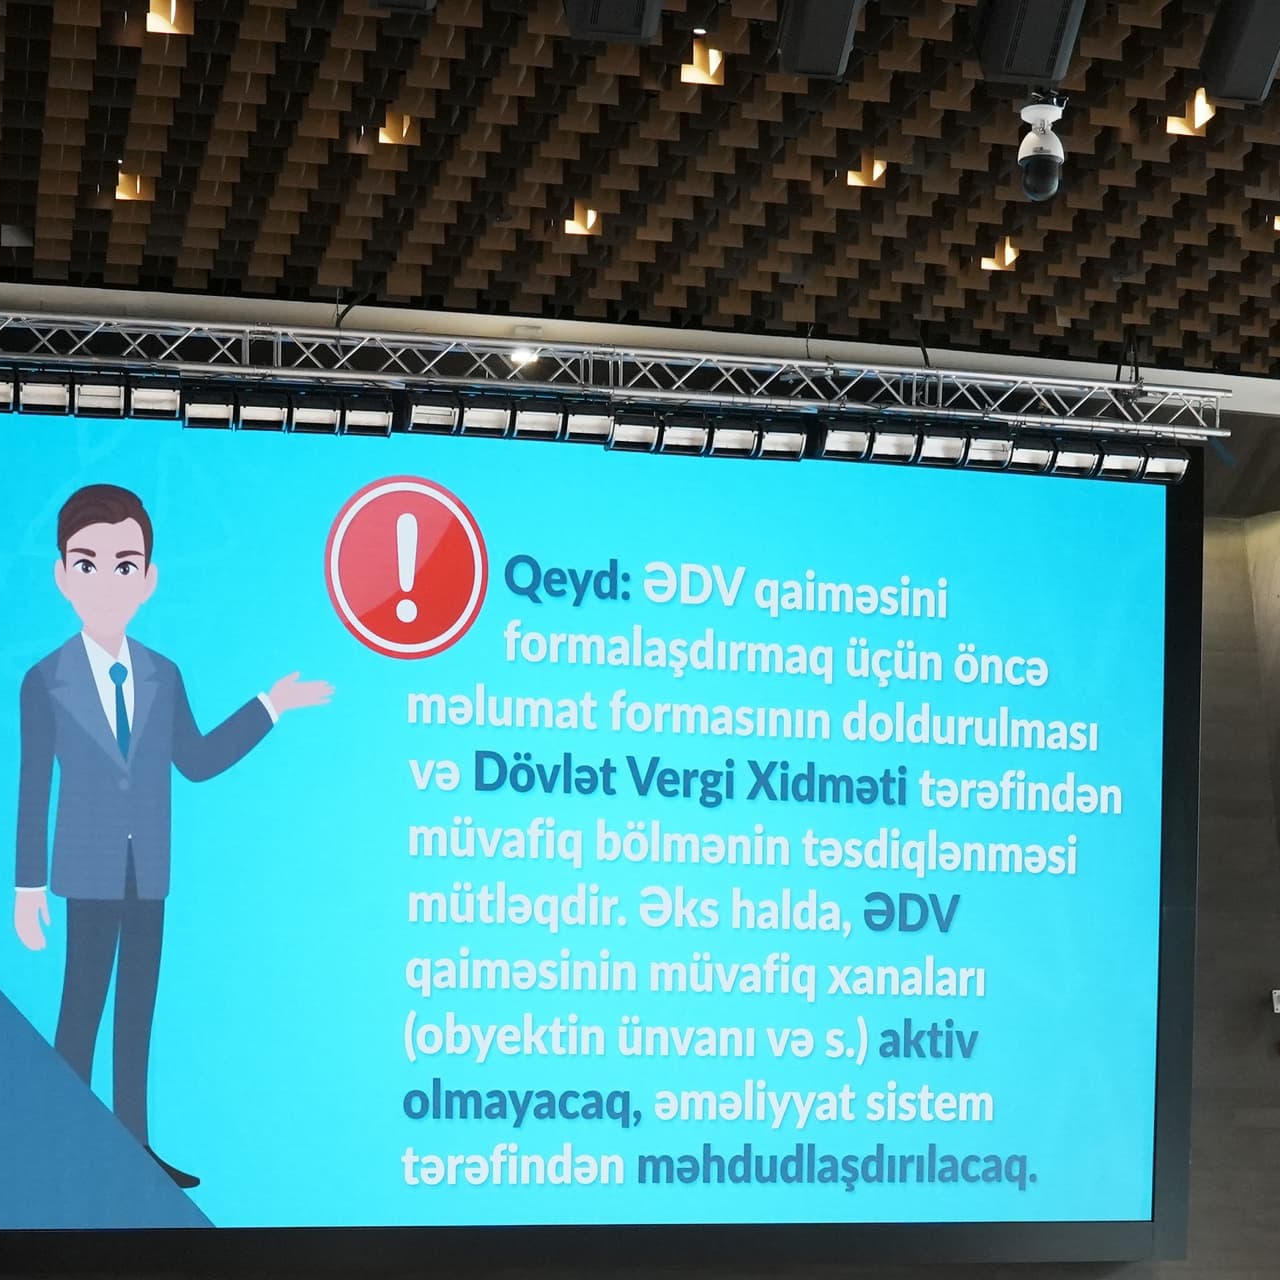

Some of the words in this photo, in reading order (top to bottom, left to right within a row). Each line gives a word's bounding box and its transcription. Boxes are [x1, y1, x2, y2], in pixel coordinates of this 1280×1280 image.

[505, 555, 630, 607] Qeyd:
[644, 562, 745, 605] ƏDV
[755, 570, 947, 617] qaiməsini
[504, 620, 832, 683] formalaşdırmaq
[847, 638, 941, 687] üçün
[954, 644, 1050, 686] öncə
[408, 684, 597, 729] məlumat
[610, 689, 829, 738] formasının
[843, 700, 1099, 750] doldurulması
[410, 760, 460, 790] və
[475, 751, 616, 795] Dövlət
[626, 756, 734, 808] Vergi
[747, 760, 907, 805] Xidməti
[919, 770, 1123, 813] tərəfindən
[410, 816, 582, 868] müvafiq
[597, 819, 789, 865] bölmənin
[802, 828, 1077, 877] təsdiqlənməsi
[409, 881, 626, 933] mütləqdir.
[640, 886, 719, 928] Əks
[732, 887, 851, 937] halda,
[864, 892, 960, 933] ƏDV
[406, 947, 636, 997] qaiməsinin
[650, 952, 815, 1002] müvafiq
[828, 955, 985, 996] xanaları
[405, 1010, 604, 1062] (obyektin
[619, 1016, 754, 1056] ünvanı
[767, 1028, 813, 1057] və
[826, 1016, 867, 1065] s.)
[879, 1018, 978, 1058] aktiv
[403, 1078, 641, 1128] olmayacaq,
[655, 1080, 855, 1128] əməliyyat
[867, 1081, 993, 1120] sistem
[401, 1143, 623, 1184] tərəfindən
[638, 1143, 1037, 1192] məhdudlaşdırılacaq.
